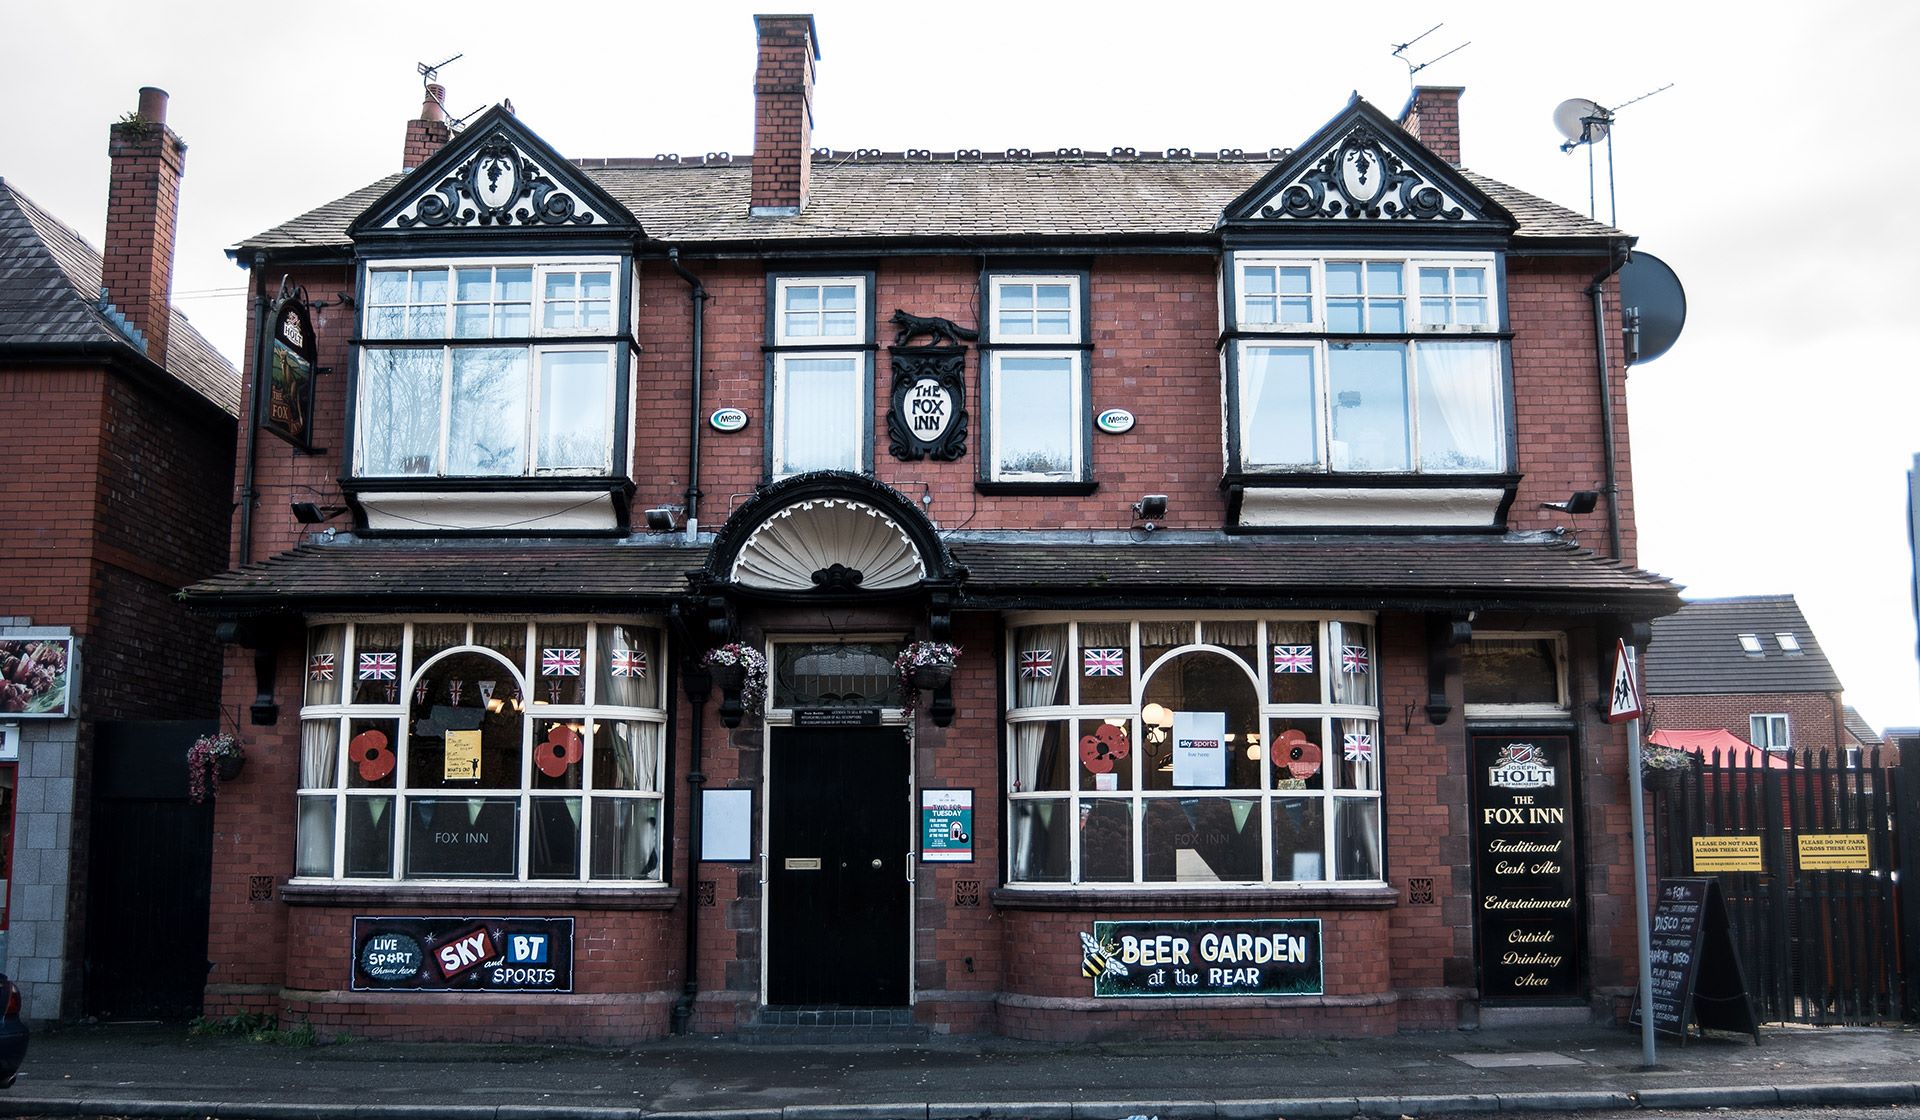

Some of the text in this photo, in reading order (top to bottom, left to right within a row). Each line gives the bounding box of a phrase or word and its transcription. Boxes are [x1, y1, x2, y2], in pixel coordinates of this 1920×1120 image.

[284, 322, 303, 344] HOLT
[915, 385, 940, 397] THE
[272, 404, 289, 420] FOX
[912, 399, 944, 415] FOX
[720, 415, 741, 423] Mono
[914, 416, 940, 431] INN
[1180, 740, 1192, 748] sky
[1493, 770, 1551, 782] HOLT
[1513, 796, 1534, 804] THE
[1484, 808, 1564, 824] FOX INN
[435, 832, 489, 843] FOX INN
[1174, 833, 1230, 845] FOX INN
[1488, 839, 1561, 853] Traditional
[1495, 861, 1561, 874] Cask Ales
[1672, 886, 1686, 900] FOX
[1484, 895, 1571, 909] Entertainment
[1654, 916, 1679, 931] DISCO
[1508, 929, 1554, 943] Outside
[374, 939, 398, 951] LIVE
[440, 932, 545, 971] SKY and BT
[1121, 933, 1306, 966] BEER GARDEN
[1501, 951, 1561, 968] Drinking
[1672, 952, 1690, 965] DISCO
[398, 966, 417, 975] here
[493, 968, 556, 984] SPORTS
[1148, 968, 1260, 985] at the REAR
[1652, 967, 1682, 980] PLAY YOUR
[1514, 973, 1549, 987] Area
